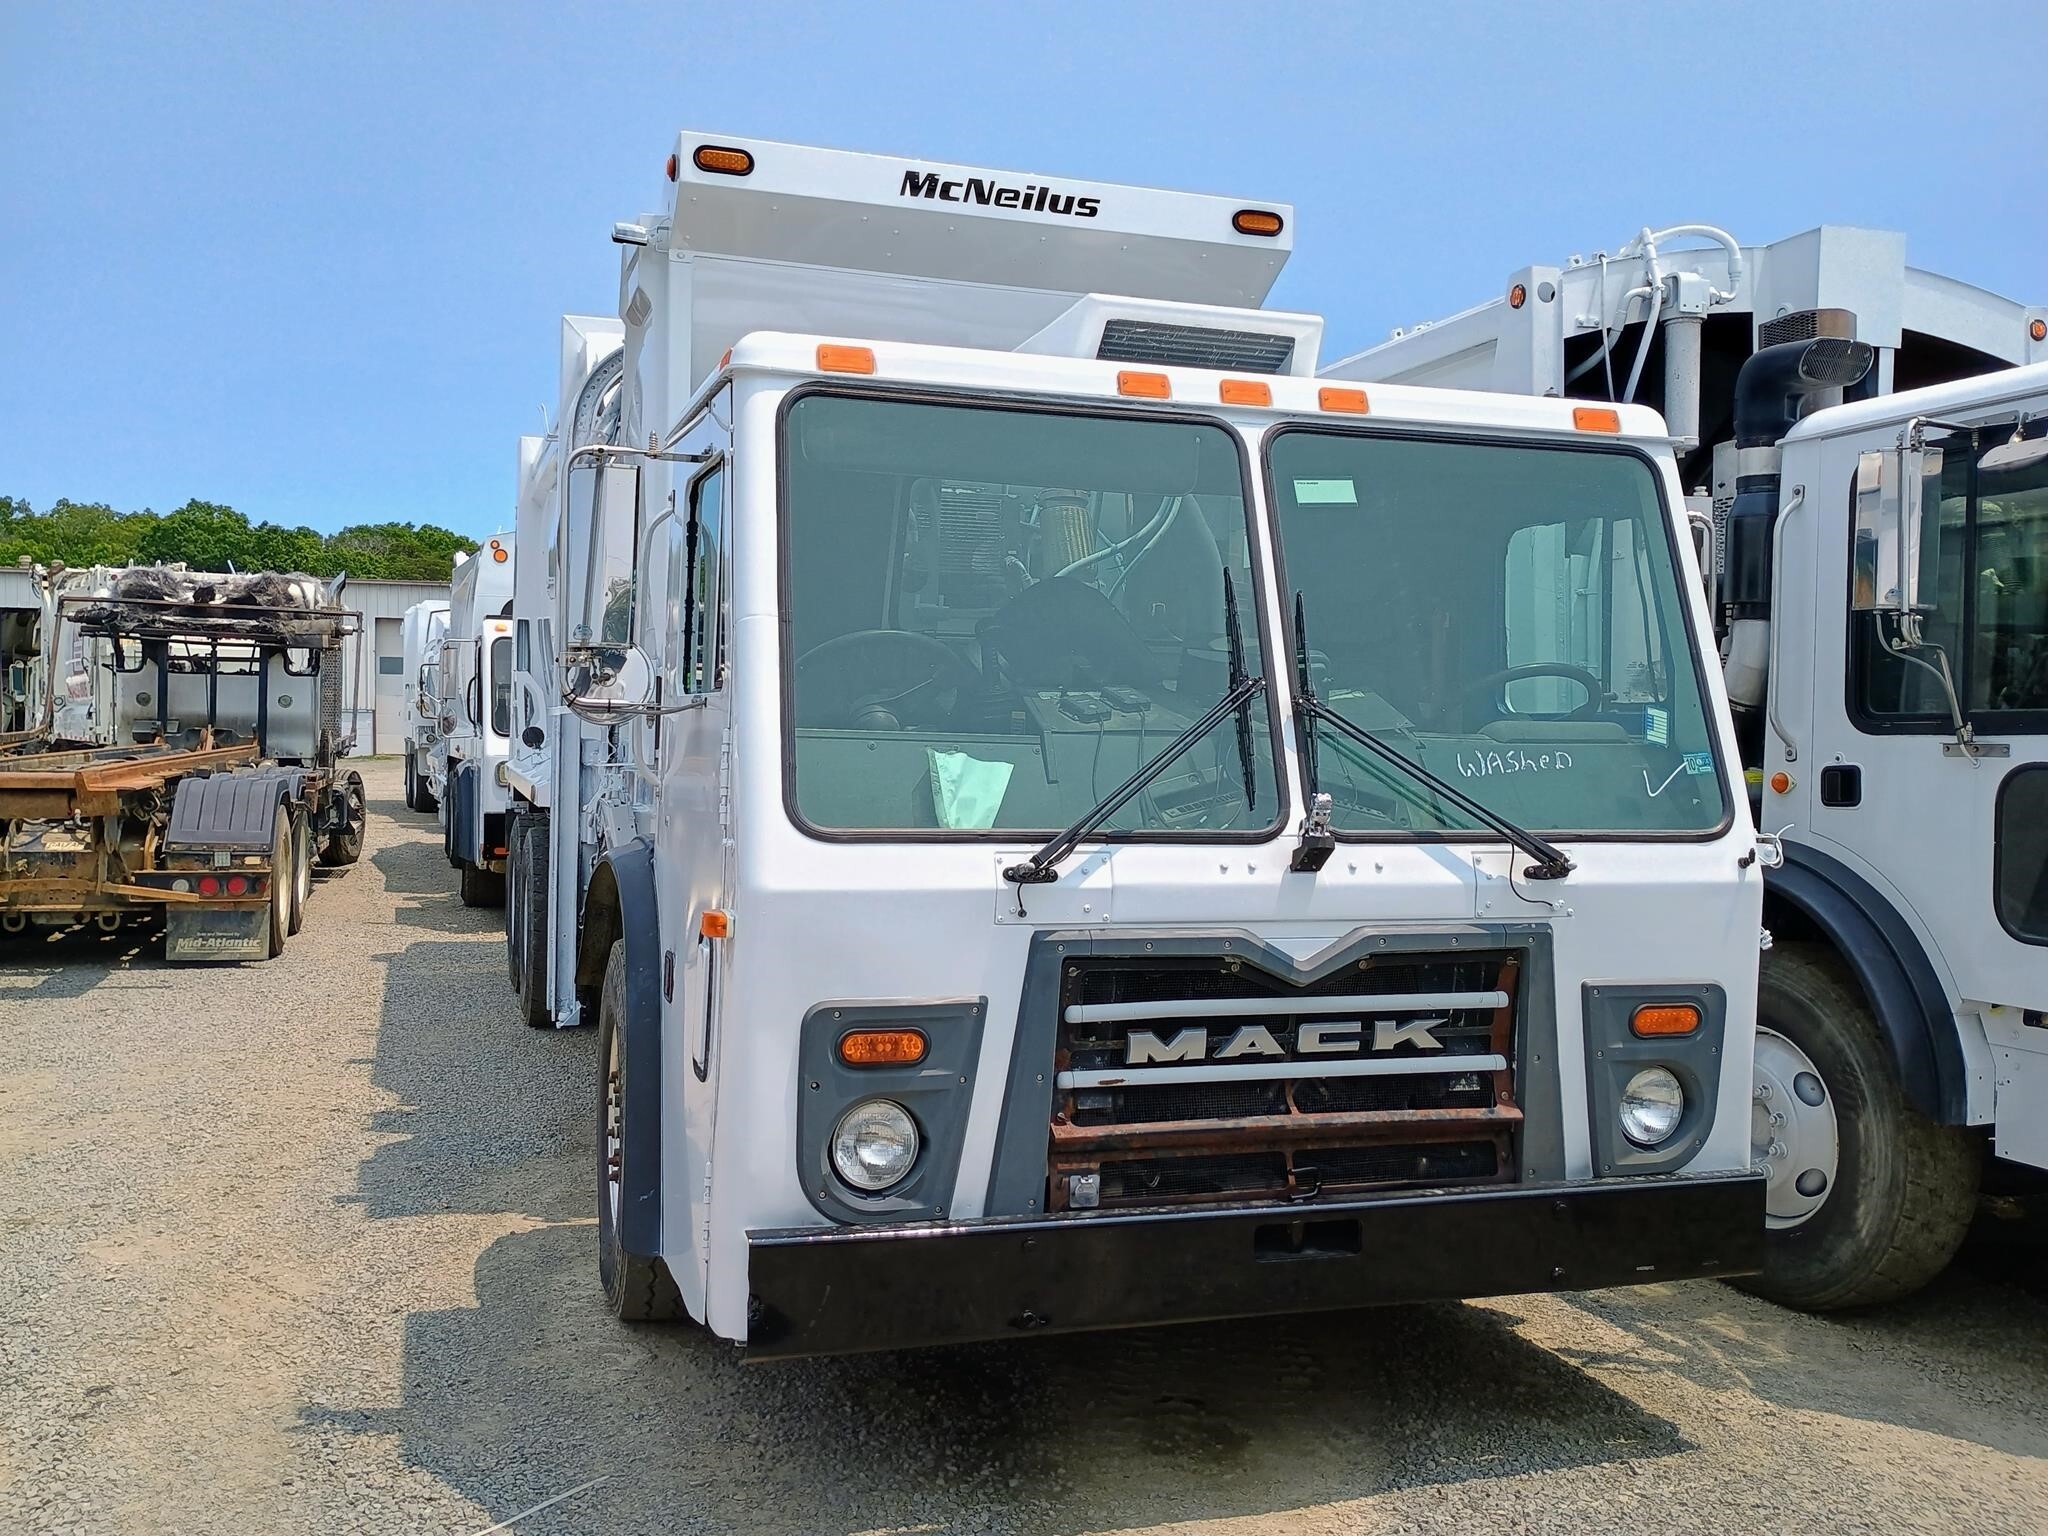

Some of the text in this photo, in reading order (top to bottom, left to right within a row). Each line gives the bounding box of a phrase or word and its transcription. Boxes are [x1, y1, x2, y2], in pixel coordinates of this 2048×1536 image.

[900, 170, 1100, 217] McNeilus
[175, 938, 261, 952] Mid-Atlantic
[1126, 1018, 1448, 1064] MACK
